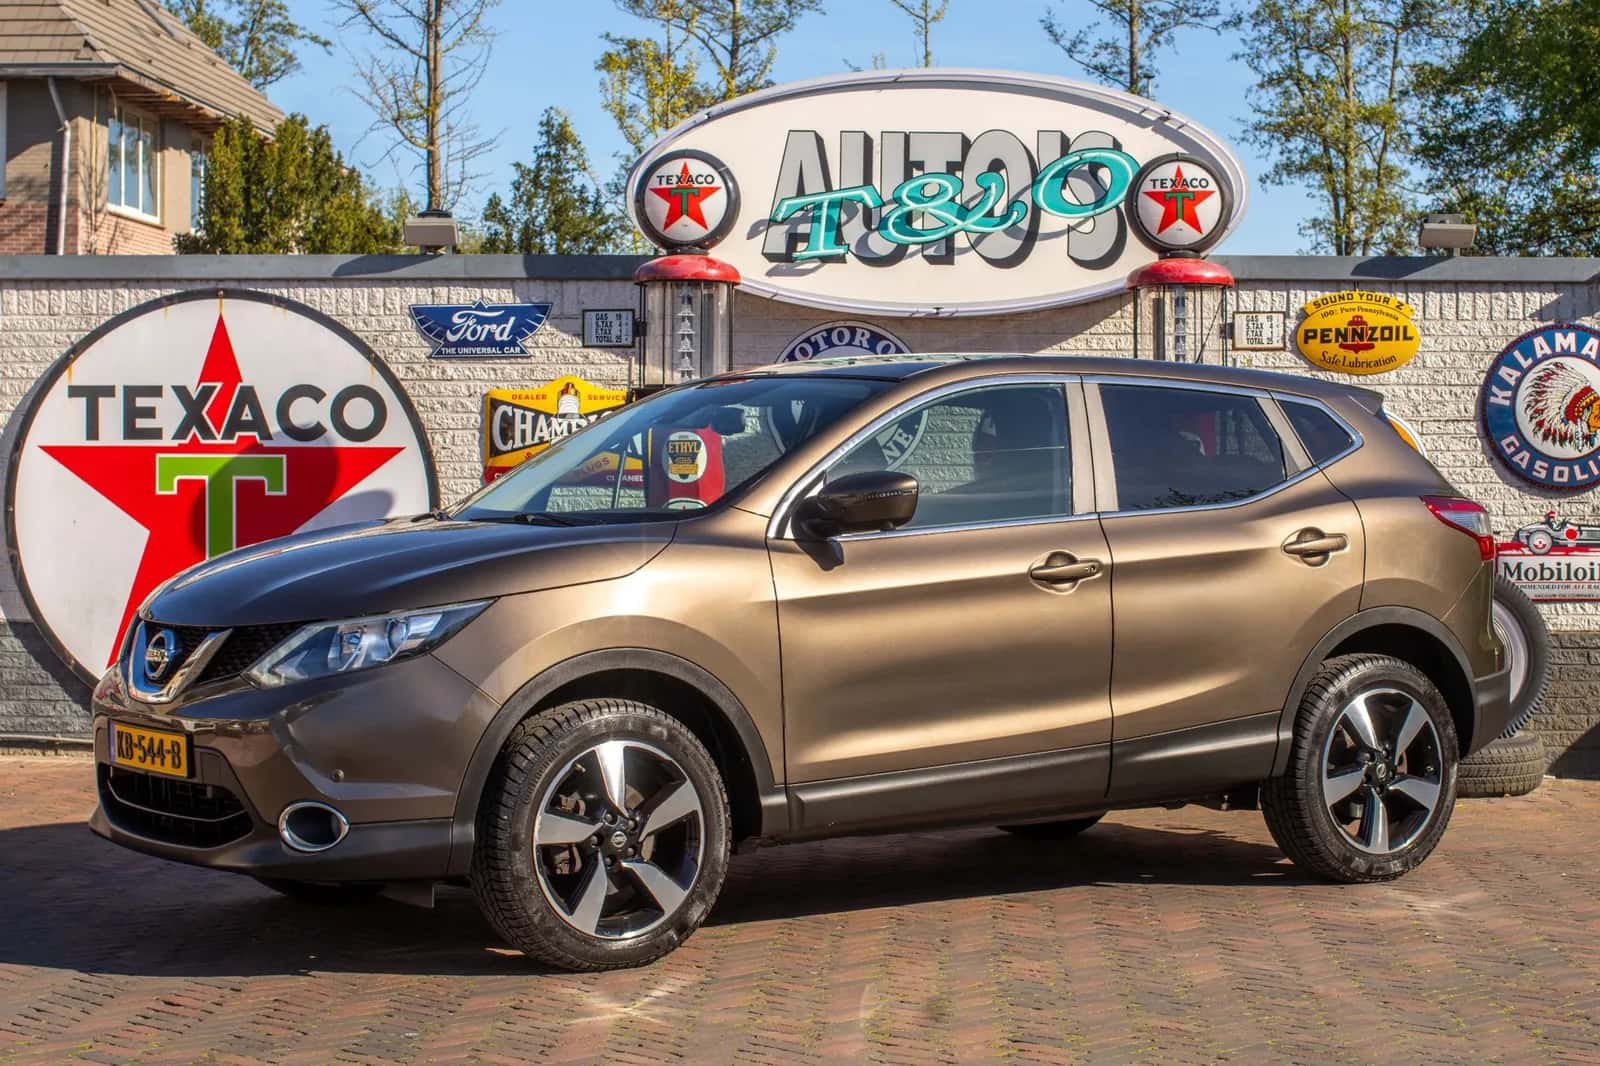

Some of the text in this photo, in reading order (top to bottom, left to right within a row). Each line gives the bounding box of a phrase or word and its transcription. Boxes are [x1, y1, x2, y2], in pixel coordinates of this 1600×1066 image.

[656, 174, 715, 186] TEXACO
[1150, 178, 1209, 190] TEXACO
[762, 129, 1128, 270] AUTO'S
[1313, 292, 1354, 309] SOUND
[1358, 292, 1390, 305] YOUR
[1340, 306, 1356, 314] Pure
[446, 310, 516, 342] Ford
[1303, 325, 1414, 345] PENNZOIL
[595, 335, 613, 343] TOTAL
[782, 327, 871, 361] OTOR
[1320, 350, 1397, 369] Safe Lubrication
[511, 393, 548, 401] DEALER
[67, 384, 387, 442] TEXACO
[491, 404, 613, 452] CHAMP
[669, 441, 699, 453] ETHYL
[1501, 435, 1600, 482] GASOLI
[1503, 561, 1600, 581] Mobiloi
[117, 730, 182, 769] KB-544-B
